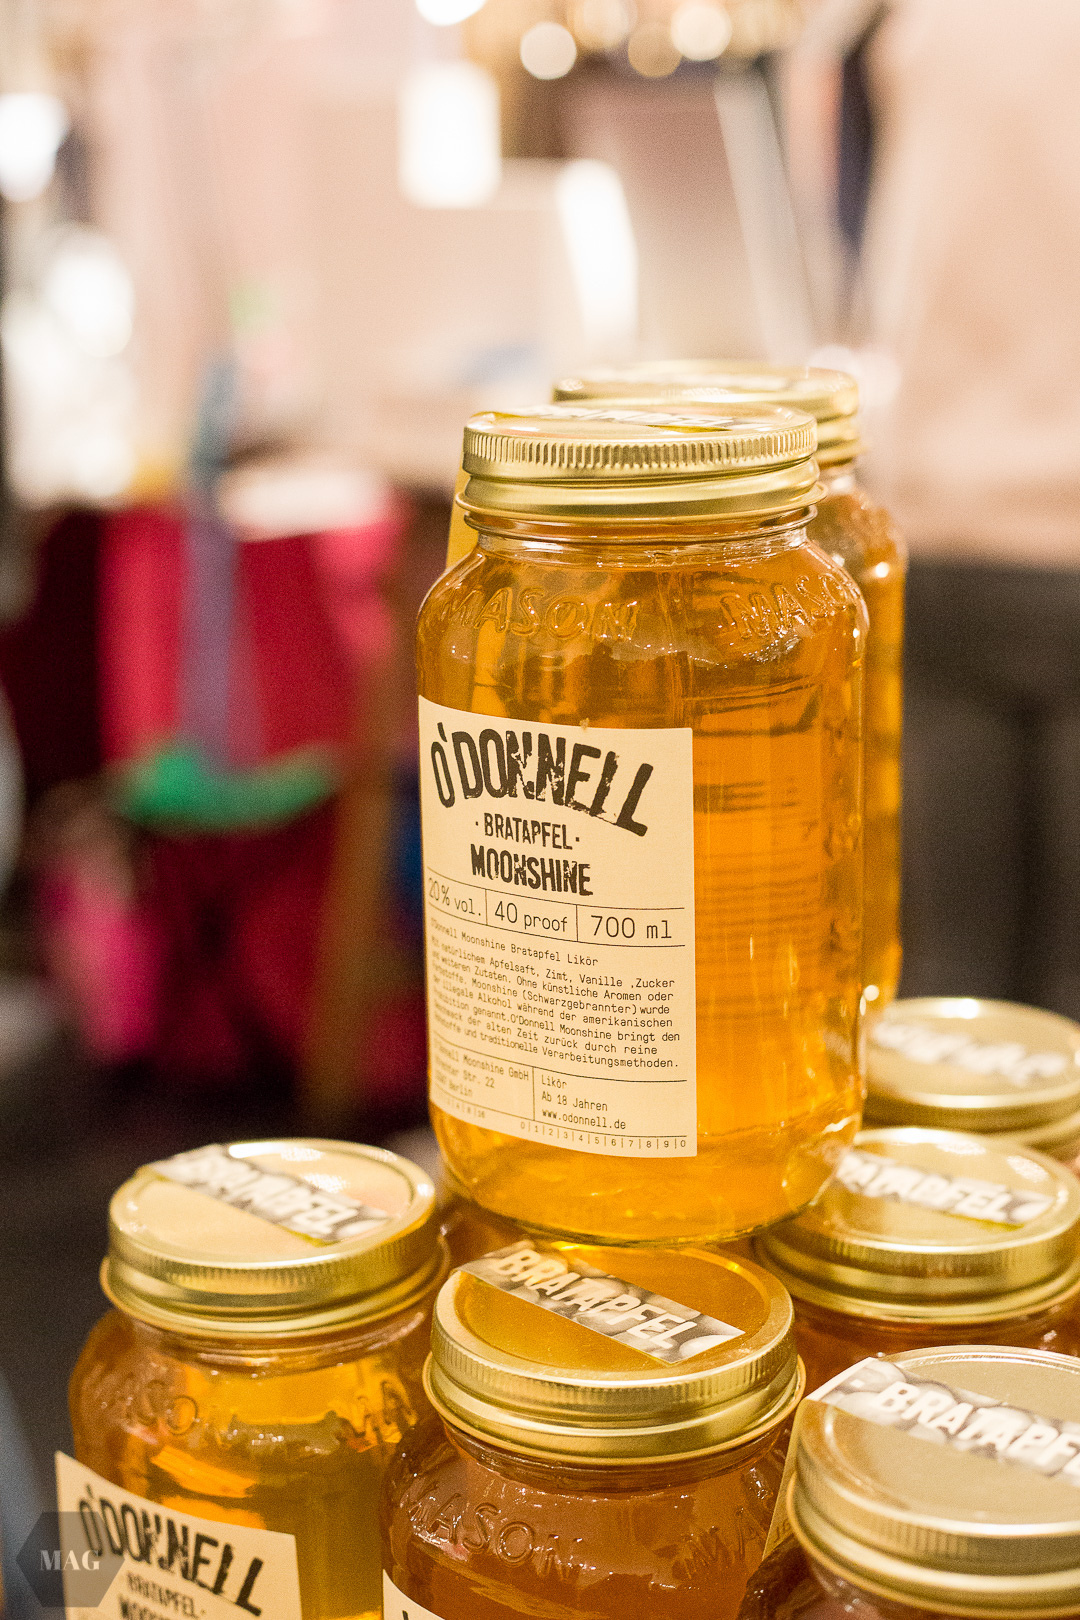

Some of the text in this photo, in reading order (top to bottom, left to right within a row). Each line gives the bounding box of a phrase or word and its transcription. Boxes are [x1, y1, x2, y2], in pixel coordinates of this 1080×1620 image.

[430, 722, 654, 837] O'DONNELL
[470, 843, 594, 896] MOONSHINE
[428, 877, 482, 917] 20% vol.
[494, 900, 568, 933] 40 proof
[590, 914, 672, 939] 700 ml
[461, 931, 506, 951] Moonshine
[511, 943, 560, 962] Bratapfel
[567, 953, 599, 966] Likör
[471, 977, 518, 997] Moonshine
[474, 965, 512, 984] Zutaten.
[516, 976, 538, 989] Ohne
[542, 981, 599, 998] künstliche
[603, 990, 642, 1001] Aromen
[647, 992, 674, 1001] oder
[579, 974, 623, 987] Vanille
[478, 992, 512, 1009] Alkohol
[517, 1002, 554, 1018] während
[559, 1011, 577, 1021] der
[582, 1016, 673, 1028] amerikanischen
[480, 1032, 538, 1054] traditionelle
[542, 1045, 679, 1068] Verarbeitungsmethoden.
[486, 1021, 512, 1035] alten
[517, 1028, 539, 1041] Zeit
[544, 1036, 578, 1049] zurück
[584, 1042, 617, 1053] durch
[624, 1045, 658, 1055] reine
[559, 1024, 612, 1040] Moonshine
[617, 1031, 656, 1044] bringt
[661, 1032, 680, 1041] den
[463, 1054, 505, 1076] Moonshine
[508, 1067, 529, 1081] GmbH
[541, 1074, 568, 1089] Likör
[541, 1091, 608, 1112] Ab 18 Jahren
[541, 1108, 627, 1130] www.odonnell.de
[493, 1248, 697, 1350] BRATAPFEL
